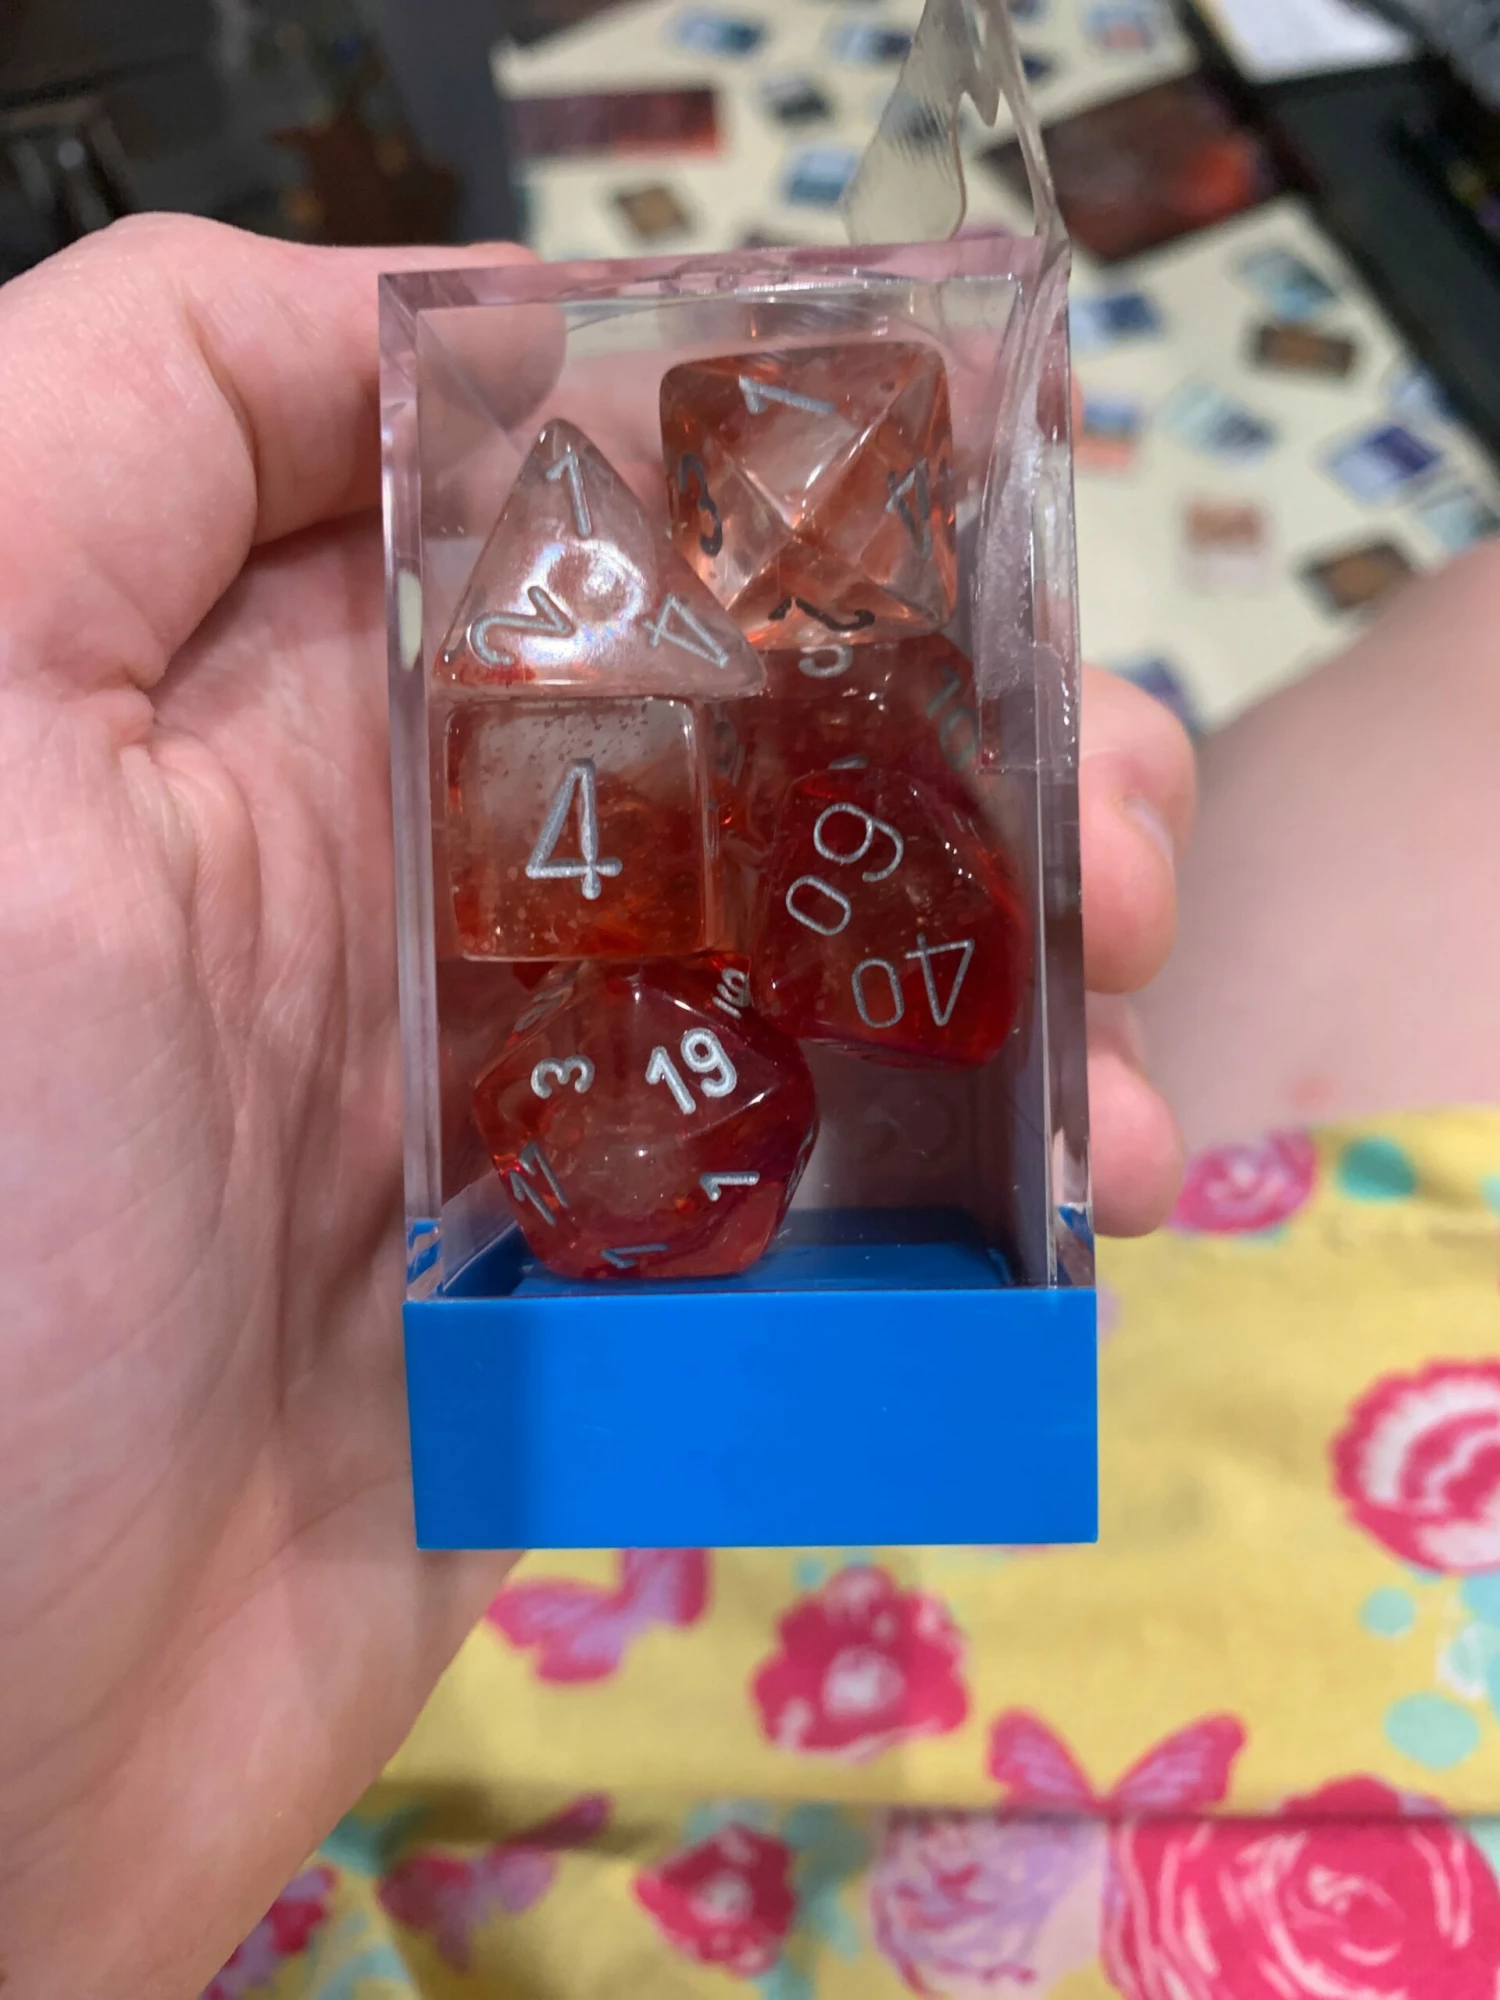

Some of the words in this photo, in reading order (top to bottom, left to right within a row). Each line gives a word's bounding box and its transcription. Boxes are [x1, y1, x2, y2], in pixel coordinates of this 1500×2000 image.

[547, 450, 594, 538] 1
[470, 584, 578, 667] 2
[641, 595, 731, 669] 4
[525, 757, 623, 900] 4
[786, 802, 904, 936] 60
[851, 933, 974, 1029] 40
[531, 1054, 595, 1099] 3
[645, 1026, 737, 1114] 19
[700, 1171, 760, 1202] 1
